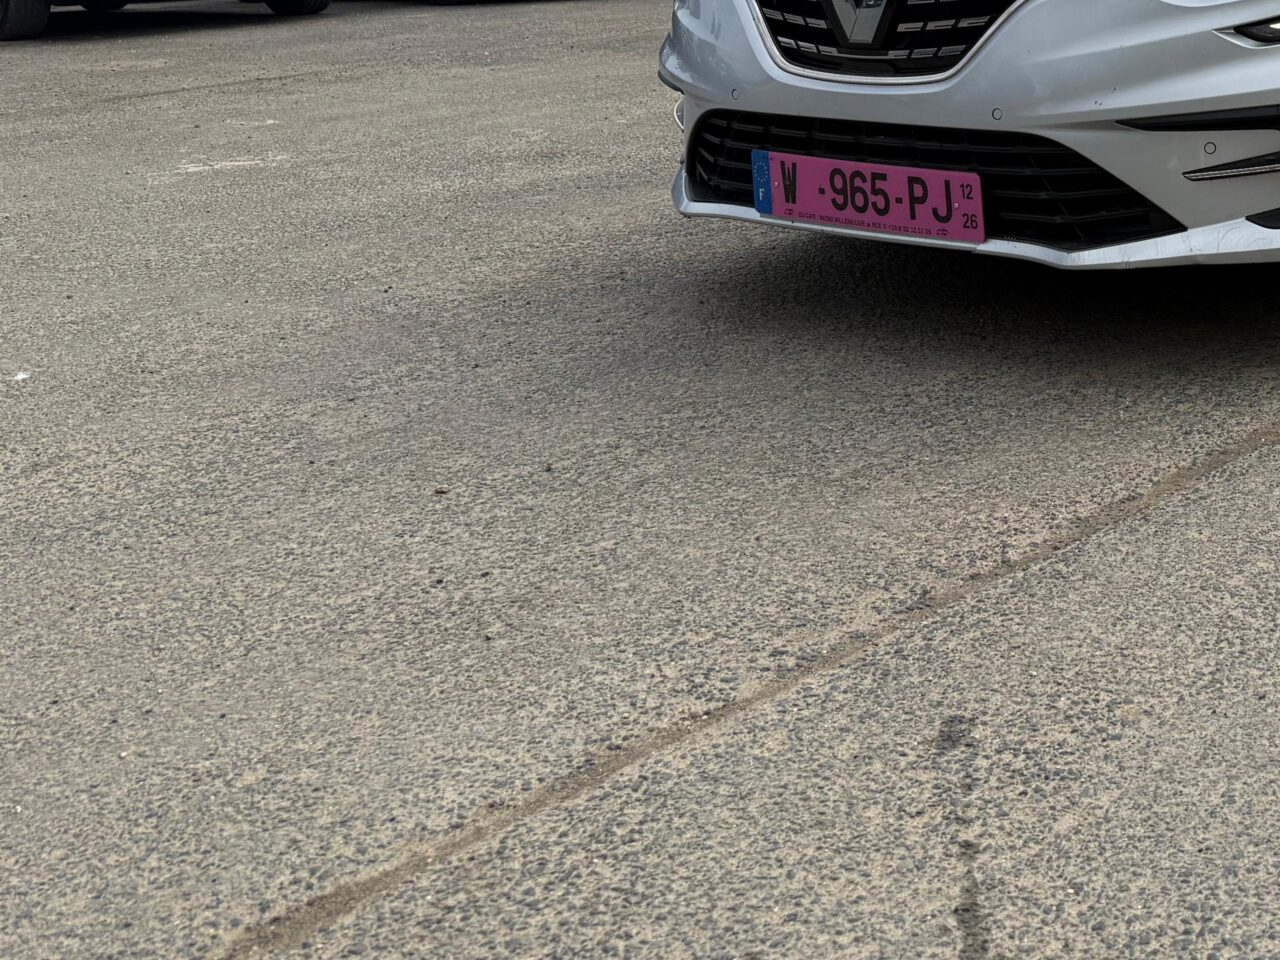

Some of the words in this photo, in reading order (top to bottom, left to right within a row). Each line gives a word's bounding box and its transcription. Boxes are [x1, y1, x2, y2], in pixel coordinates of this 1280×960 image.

[779, 159, 797, 205] W
[759, 187, 766, 201] F
[959, 183, 973, 200] 12
[962, 212, 978, 230] 26
